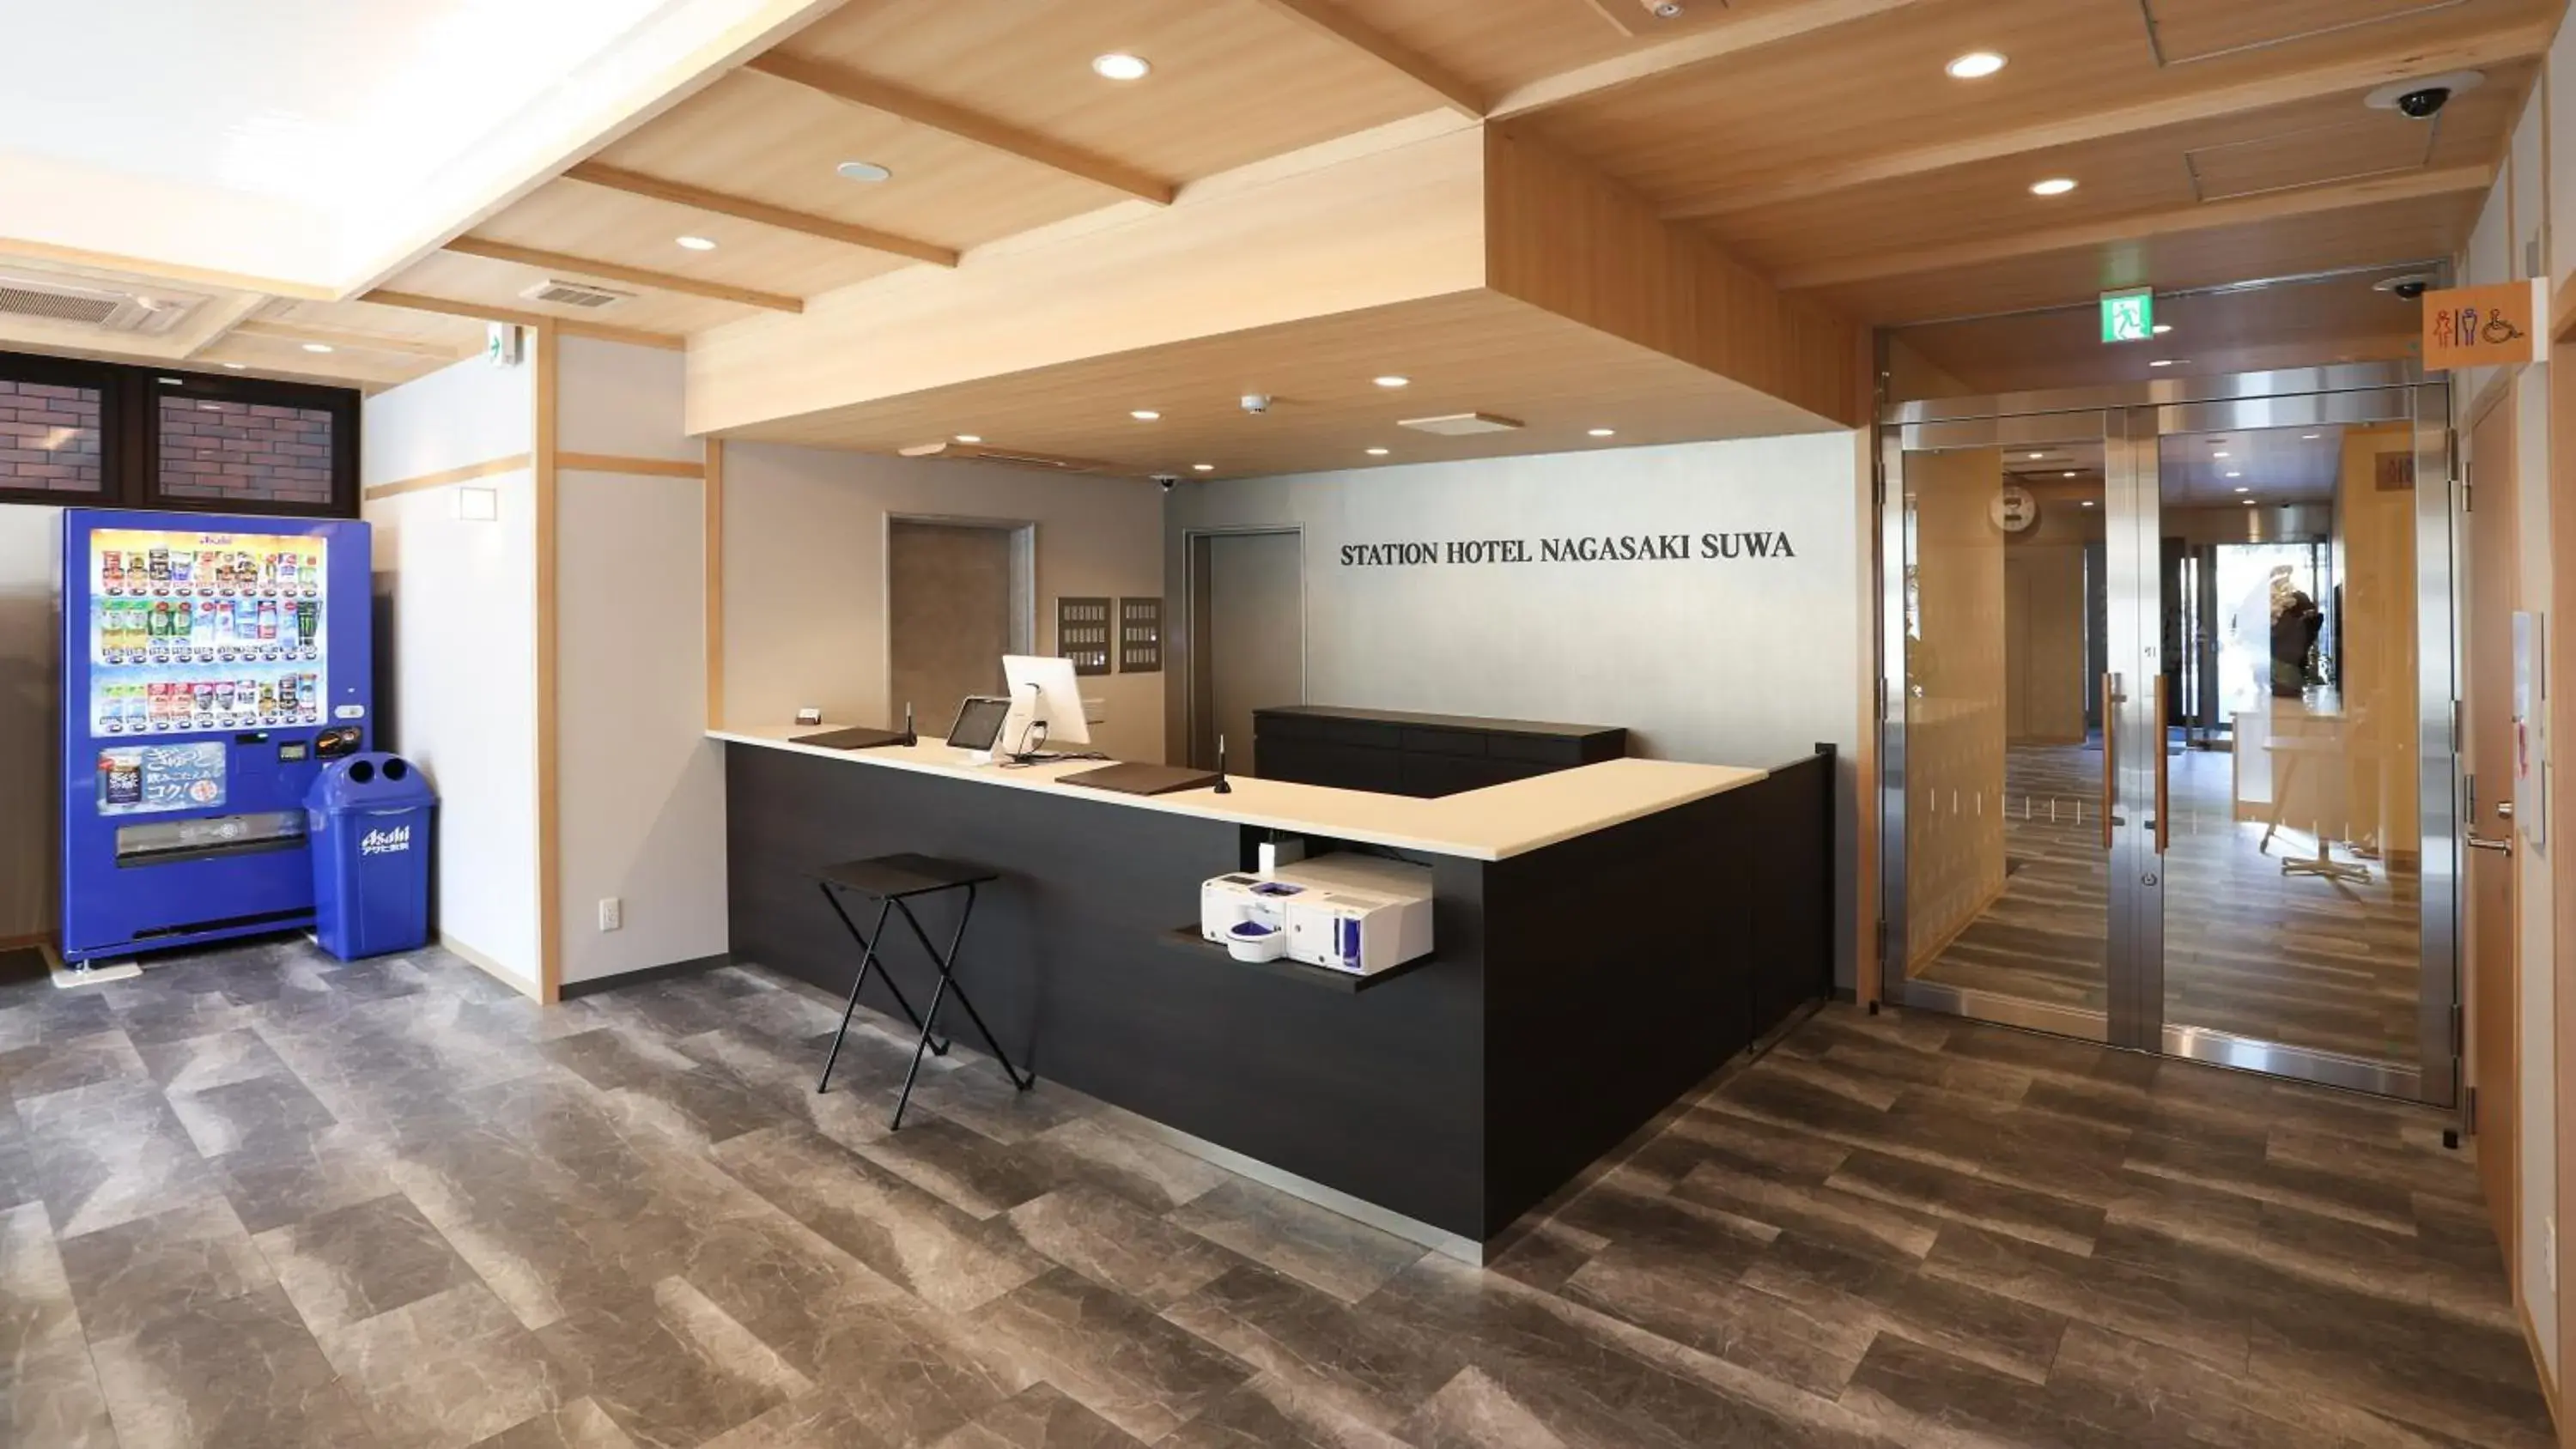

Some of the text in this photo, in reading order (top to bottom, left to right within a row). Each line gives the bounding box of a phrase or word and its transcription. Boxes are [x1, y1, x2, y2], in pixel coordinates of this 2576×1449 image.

[1340, 531, 1795, 567] STATION HOTEL NAGASAKI SUWA
[361, 825, 410, 847] Asahi
